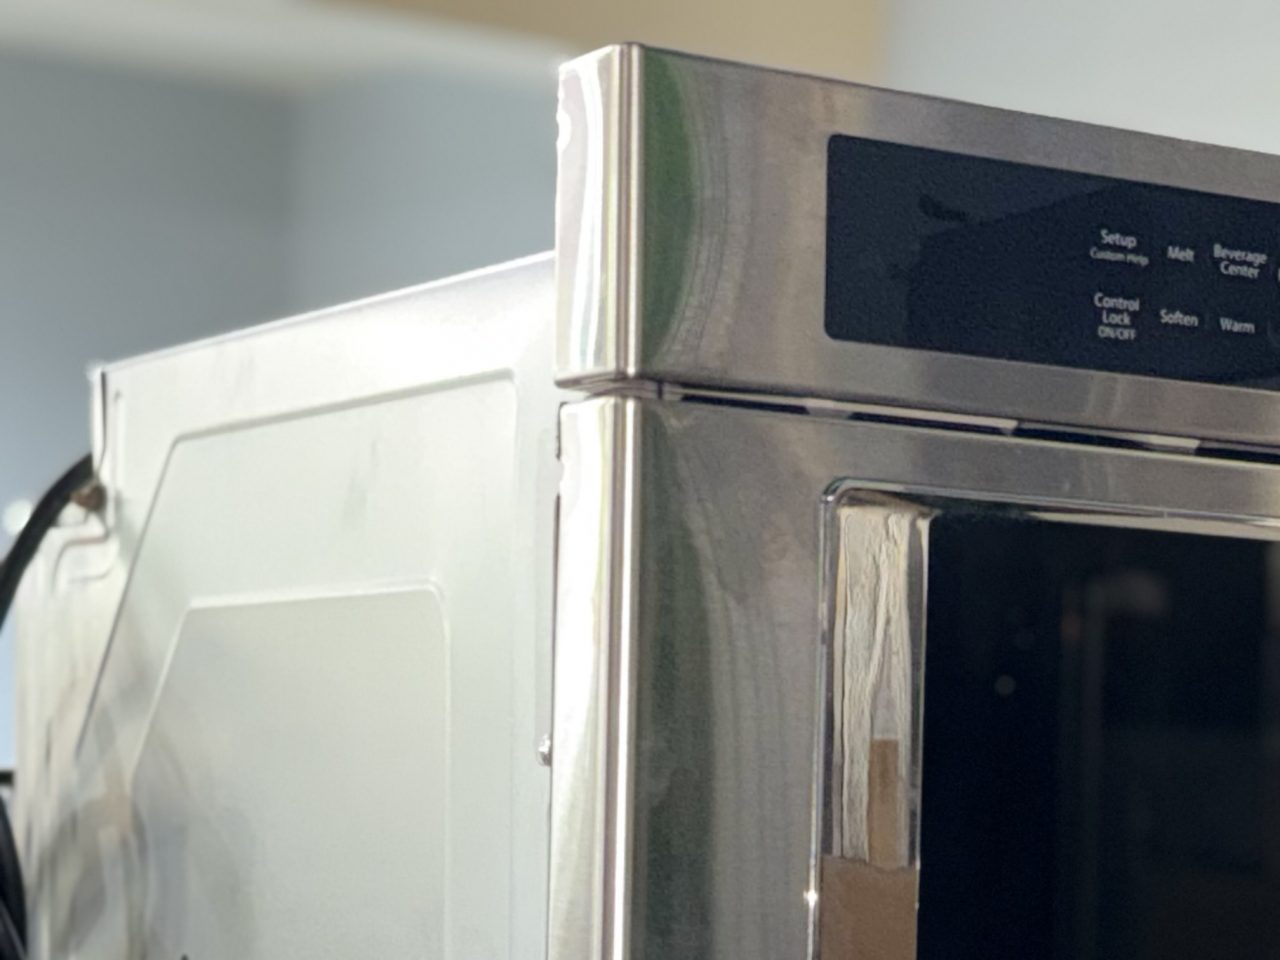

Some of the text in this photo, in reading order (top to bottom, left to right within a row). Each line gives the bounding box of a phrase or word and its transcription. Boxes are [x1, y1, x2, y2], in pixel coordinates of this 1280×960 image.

[1100, 229, 1137, 250] Setup
[1166, 246, 1195, 262] Melt
[1213, 243, 1267, 267] Beverage
[1219, 260, 1260, 279] Center
[1093, 291, 1140, 312] Control
[1102, 310, 1131, 326] Lock
[1159, 308, 1199, 327] Soften
[1219, 316, 1255, 334] Warm
